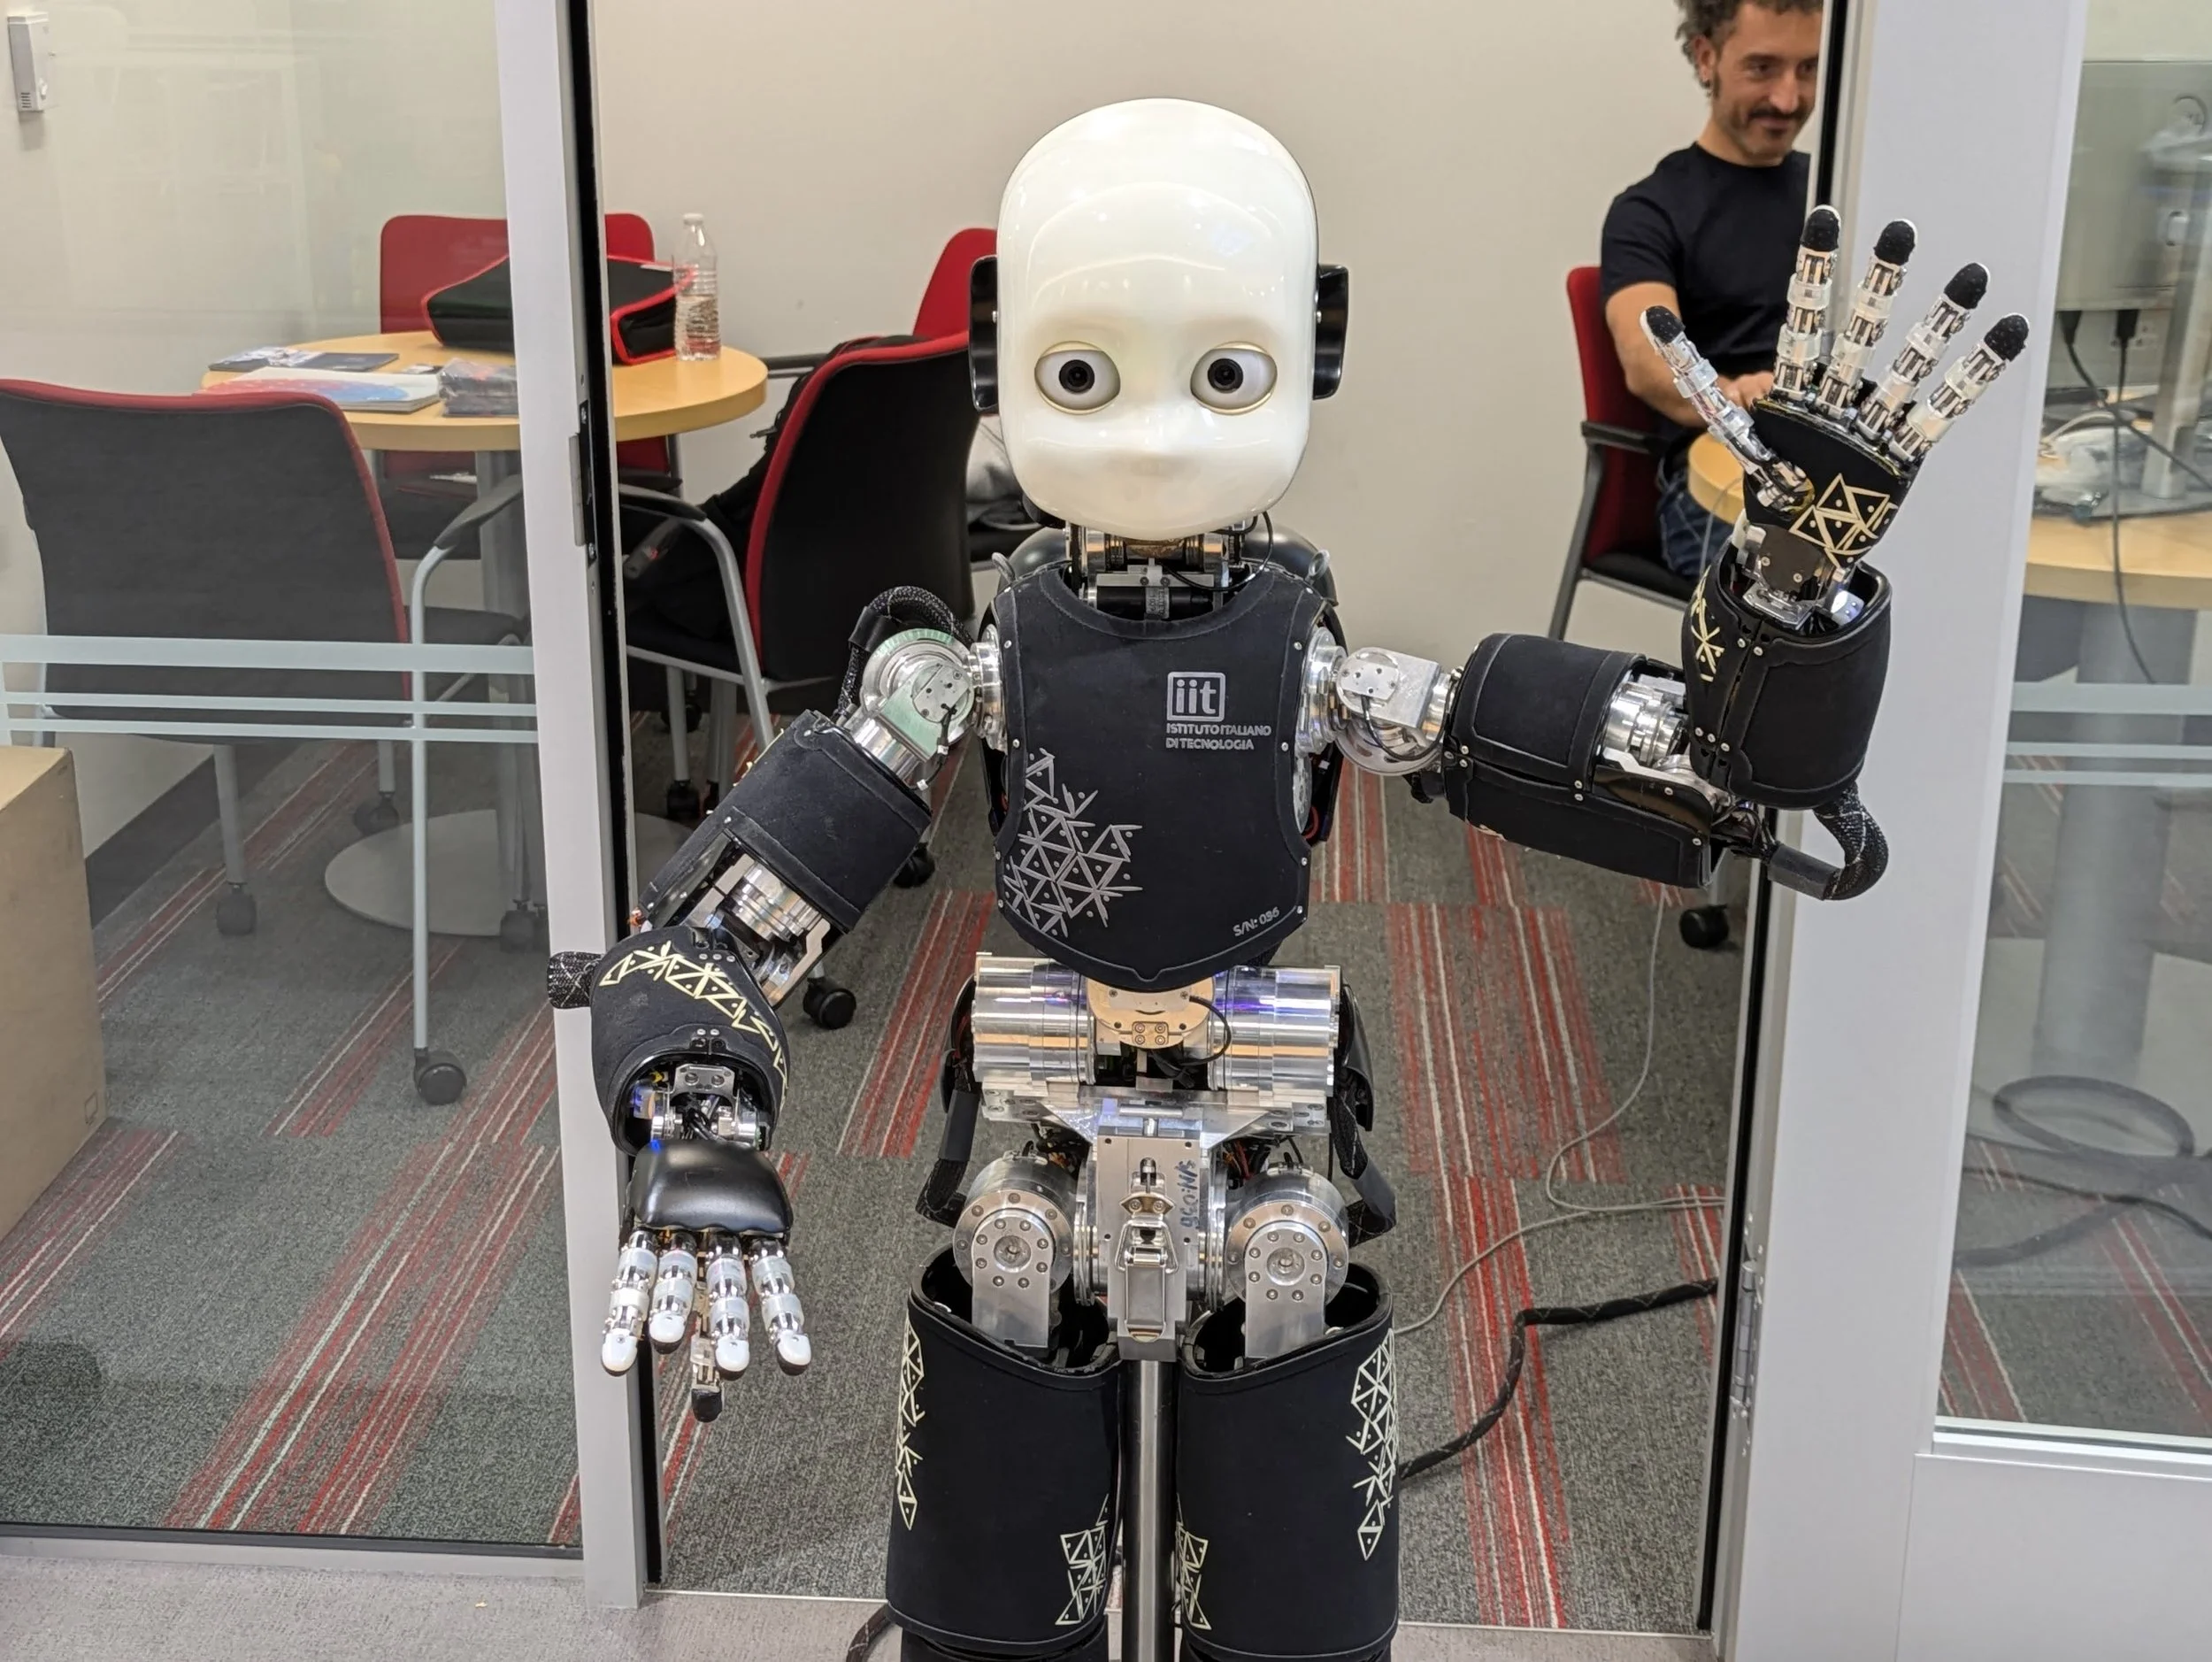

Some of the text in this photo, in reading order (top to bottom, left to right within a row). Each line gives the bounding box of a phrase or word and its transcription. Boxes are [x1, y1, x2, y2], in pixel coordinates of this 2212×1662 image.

[1175, 679, 1217, 714] iit
[1165, 723, 1271, 736] ISTITUTO ITALIANO
[1165, 737, 1256, 750] DI TECNOLOGIA
[1233, 918, 1258, 936] S/N:
